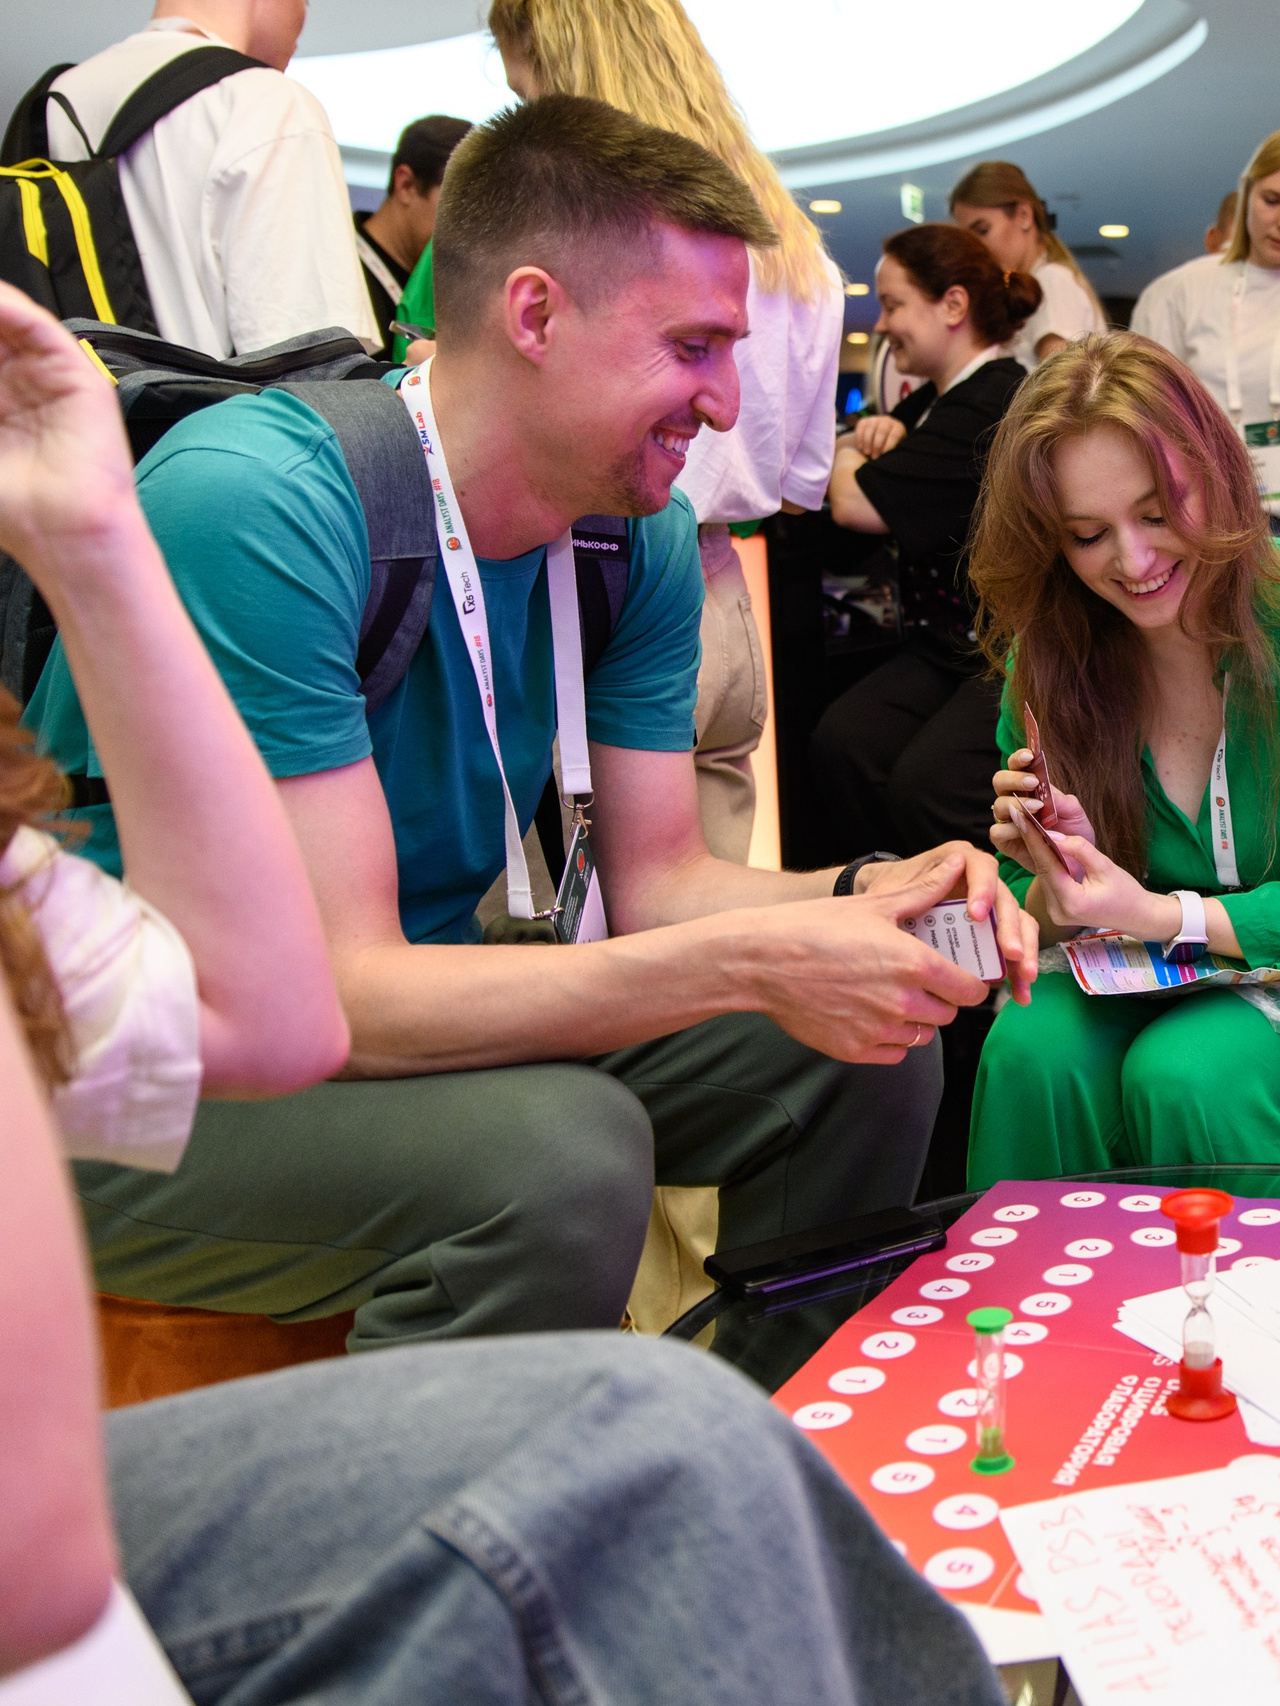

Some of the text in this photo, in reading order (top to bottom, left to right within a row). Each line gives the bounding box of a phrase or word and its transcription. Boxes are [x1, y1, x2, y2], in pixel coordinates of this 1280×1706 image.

[416, 412, 430, 445] SM Lab
[433, 478, 454, 534] ANALYST DAYS #18
[572, 539, 619, 551] ИНЬКОФФ
[460, 572, 472, 593] Tech
[477, 649, 485, 664] DAYS
[481, 664, 490, 690] ANALYST
[946, 928, 959, 965] УСТОЙЧИВОСТ
[1144, 1233, 1163, 1241] 3
[1079, 1244, 1099, 1252] 2
[934, 1285, 954, 1293] 4
[1036, 1300, 1056, 1309] 5
[1011, 1329, 1031, 1337] 4
[876, 1340, 900, 1349] 2
[811, 1411, 835, 1421] 5
[1092, 1386, 1158, 1466] ЦИФРОВАЯ
[1052, 1383, 1135, 1486] ЛАБОРАТОРИЯ
[892, 1473, 917, 1482] 5
[954, 1505, 978, 1516] 4
[946, 1561, 974, 1574] 5
